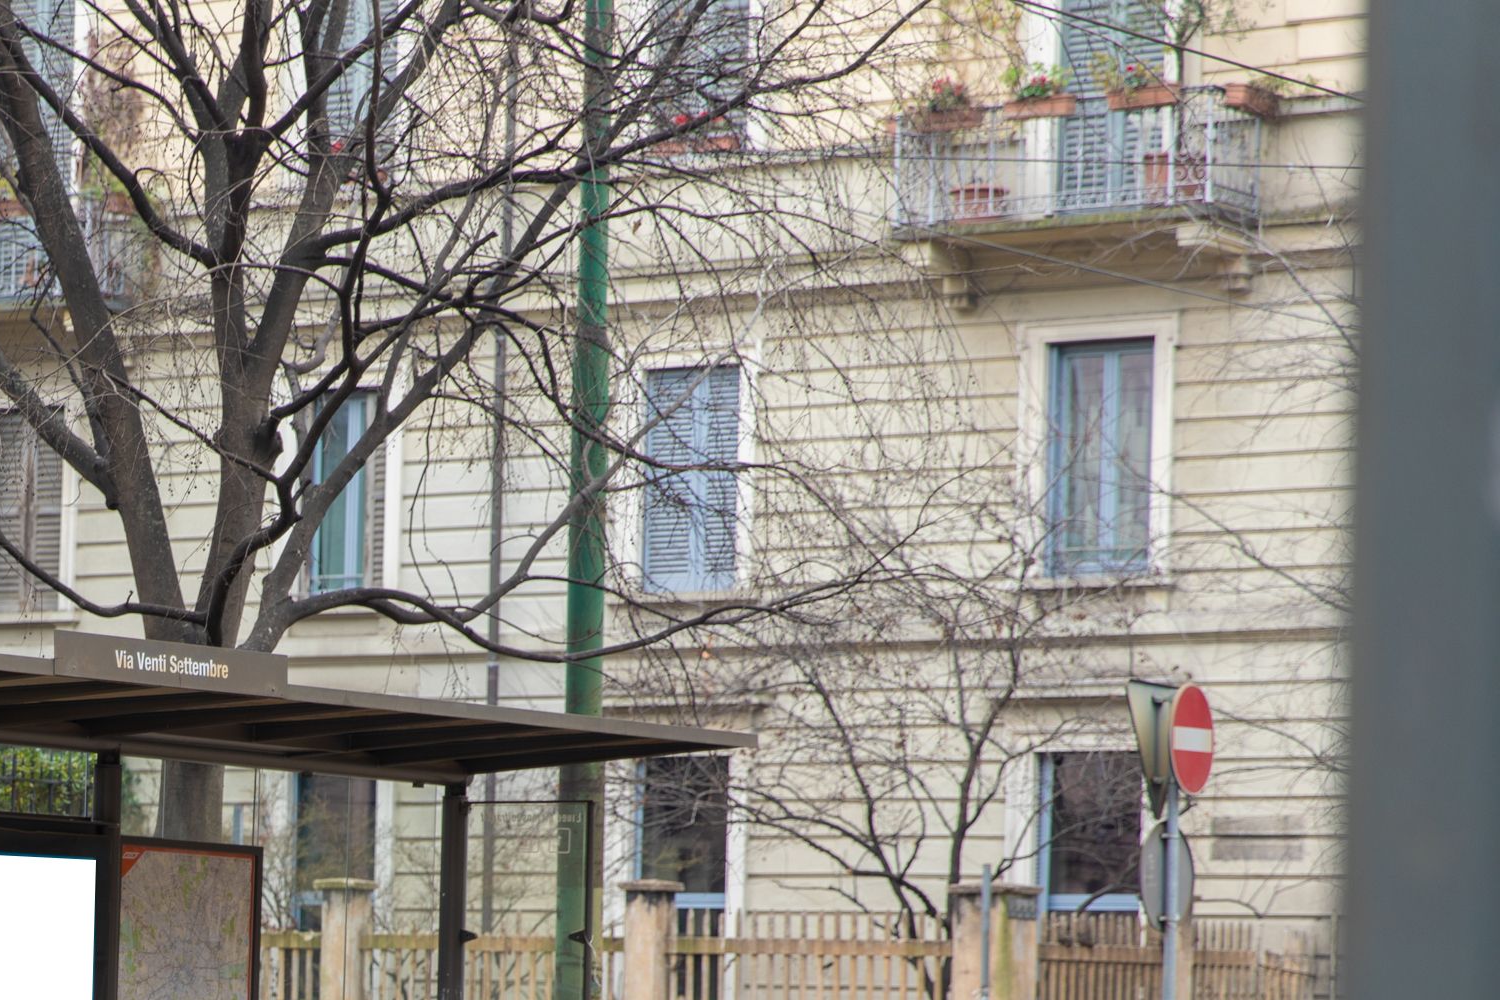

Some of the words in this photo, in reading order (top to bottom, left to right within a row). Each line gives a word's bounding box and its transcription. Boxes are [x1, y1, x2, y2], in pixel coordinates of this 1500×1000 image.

[115, 650, 134, 670] Via
[137, 652, 167, 672] Venti
[169, 655, 229, 679] Settembre
